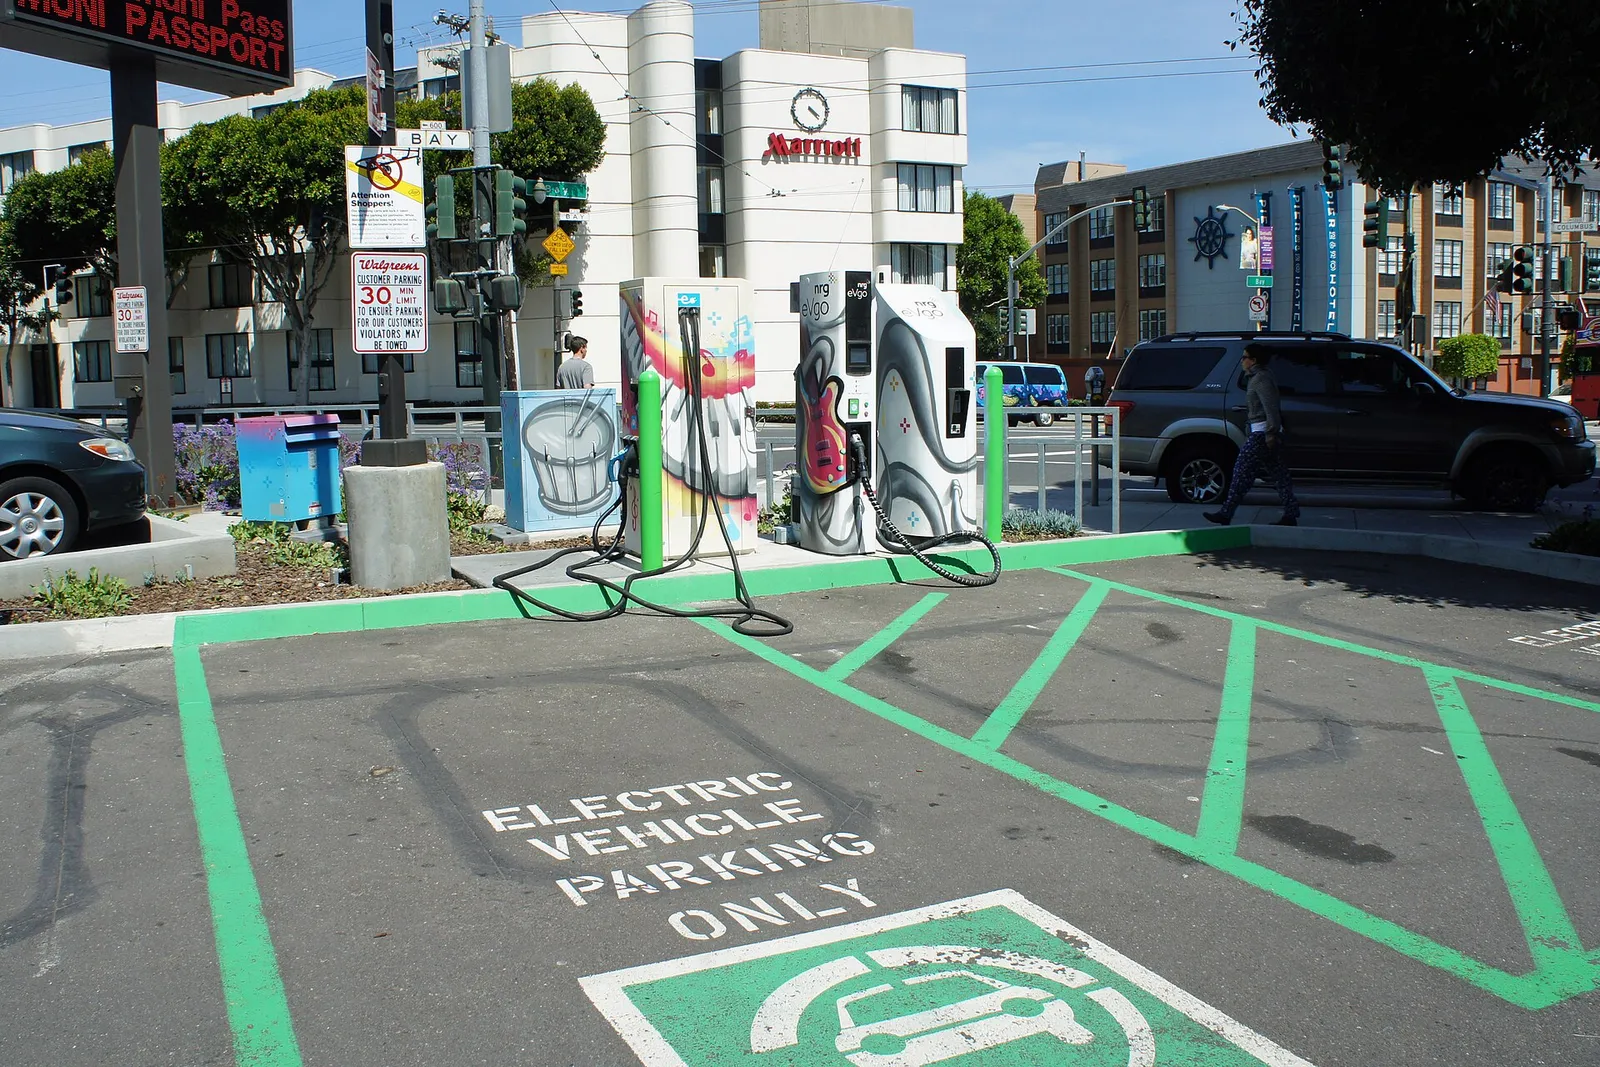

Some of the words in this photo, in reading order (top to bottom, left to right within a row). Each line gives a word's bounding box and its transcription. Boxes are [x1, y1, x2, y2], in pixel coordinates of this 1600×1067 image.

[145, 0, 204, 20] uni
[221, 0, 285, 41] Pass
[126, 3, 285, 72] PASSPORT
[412, 134, 458, 146] BAY
[763, 132, 861, 157] Marriott
[1326, 190, 1336, 228] PIER
[359, 259, 420, 273] Walgreens
[357, 275, 390, 284] CUSTOMER
[394, 275, 422, 284] PARKING
[361, 287, 391, 304] 30
[814, 283, 830, 297] nrg
[847, 289, 867, 299] eVgo
[801, 299, 830, 320] eVgo
[915, 300, 937, 308] nrg
[1327, 274, 1336, 331] HOTEL
[118, 310, 131, 321] 30
[358, 307, 365, 316] TO
[369, 307, 392, 316] ENSURE
[396, 307, 422, 316] PARKING
[901, 308, 944, 320] eVgo
[357, 318, 369, 327] FOR
[373, 318, 384, 327] OUR
[388, 318, 423, 327] CUSTOMERS
[360, 330, 400, 338] VIOLATORS
[406, 330, 420, 338] MAY
[374, 341, 382, 350] BE
[386, 341, 407, 350] TOWED
[482, 772, 793, 832] ELECTRIC
[526, 798, 824, 860] VEHICLE
[555, 832, 876, 907] PARKING
[668, 878, 877, 940] ONLY
